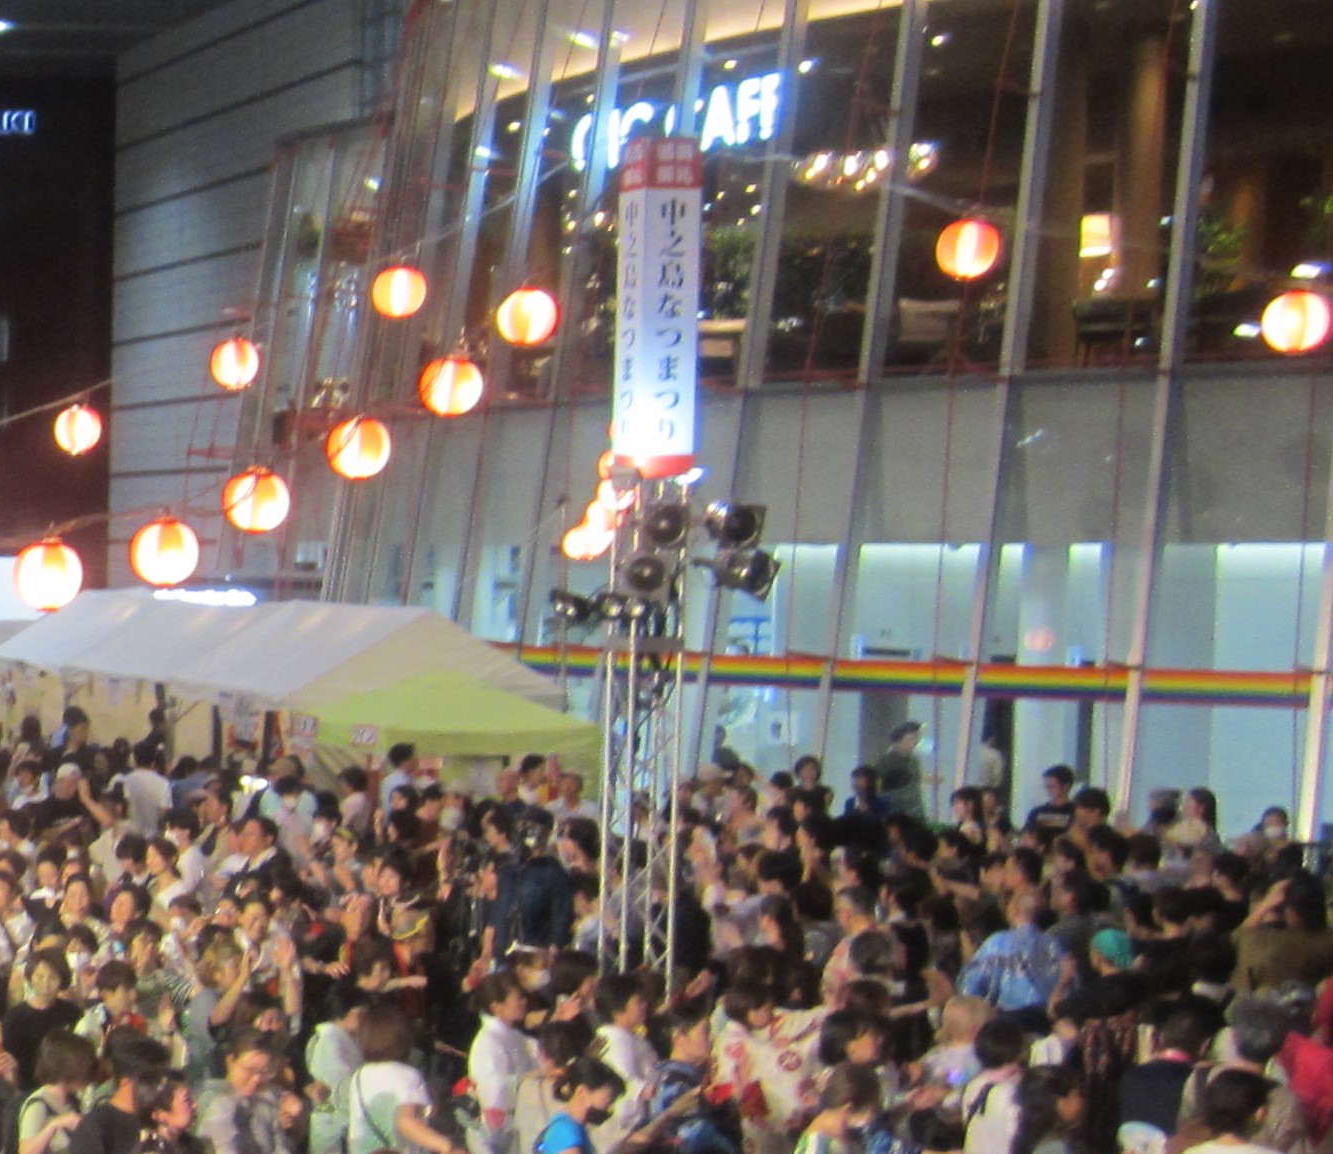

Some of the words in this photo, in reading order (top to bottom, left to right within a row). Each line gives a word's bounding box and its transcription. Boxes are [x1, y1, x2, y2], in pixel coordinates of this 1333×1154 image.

[653, 196, 688, 442] 中之島なつまつり
